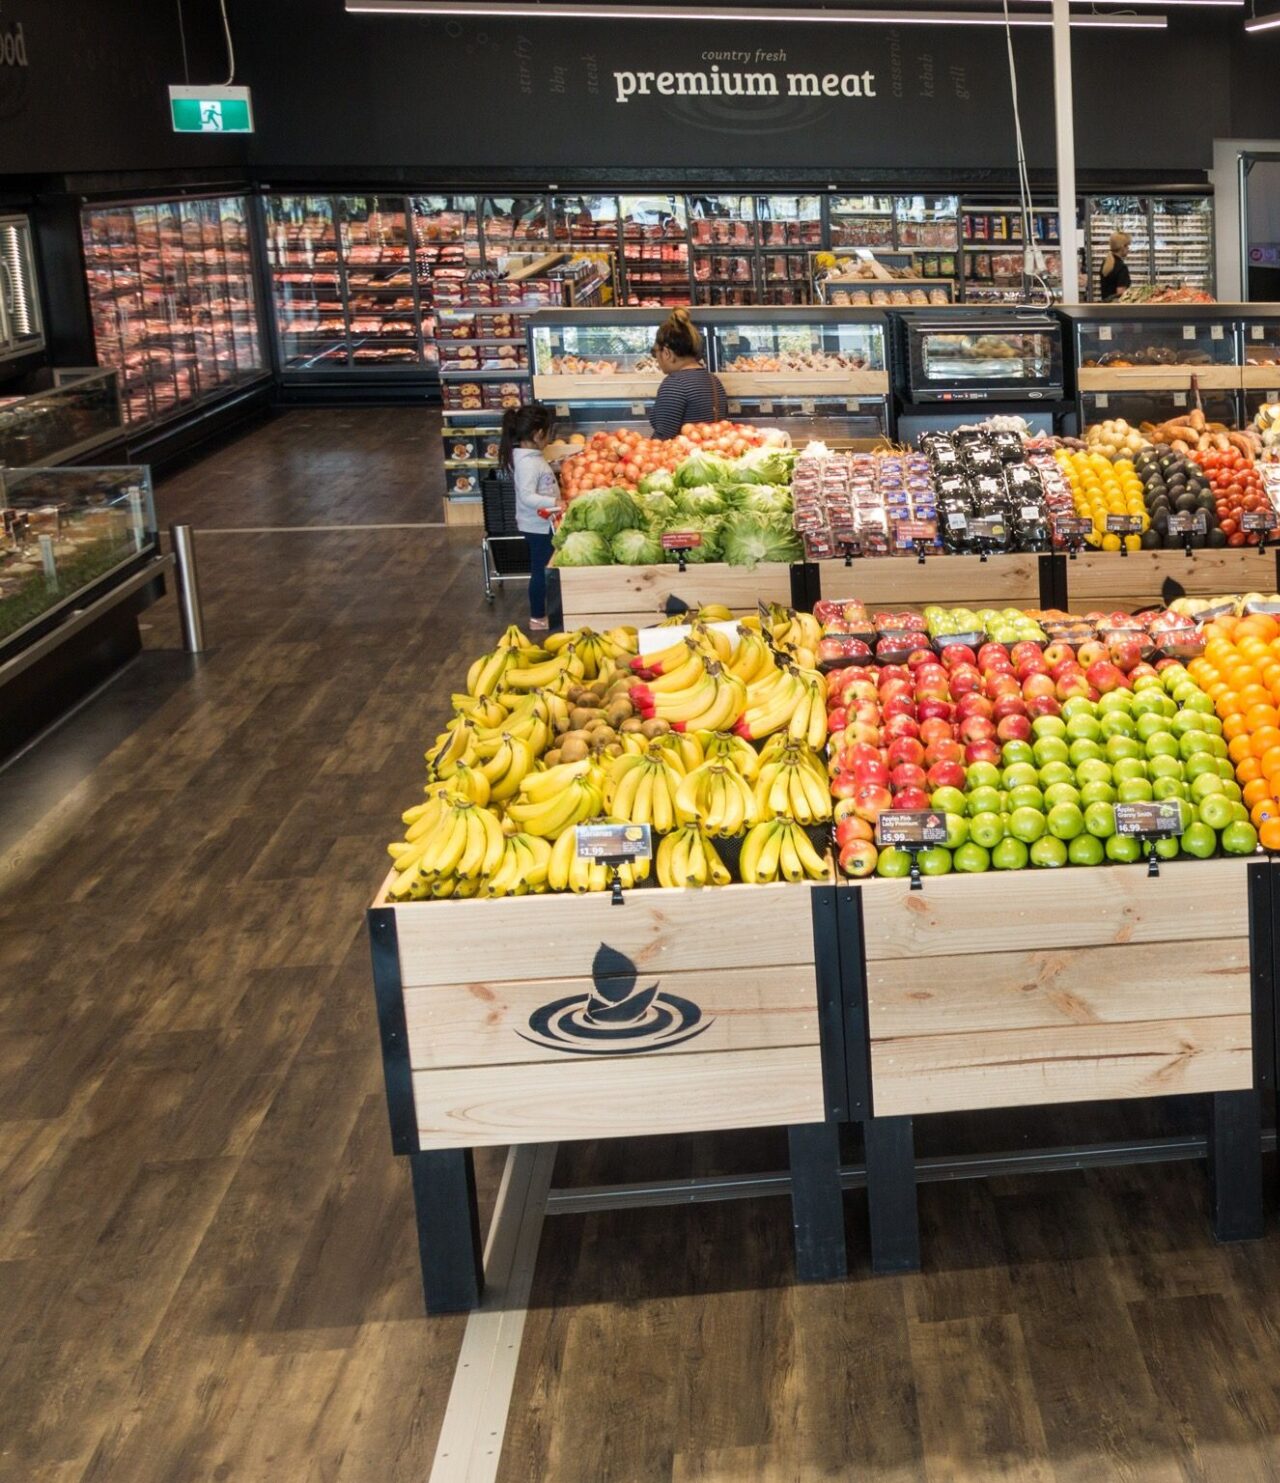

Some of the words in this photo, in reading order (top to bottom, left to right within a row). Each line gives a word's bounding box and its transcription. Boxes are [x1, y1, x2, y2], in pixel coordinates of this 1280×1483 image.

[701, 49, 751, 63] country
[754, 48, 787, 63] fresh
[613, 66, 778, 103] premium
[787, 70, 876, 98] meat
[950, 65, 970, 100] grill
[882, 833, 905, 842] $5.99
